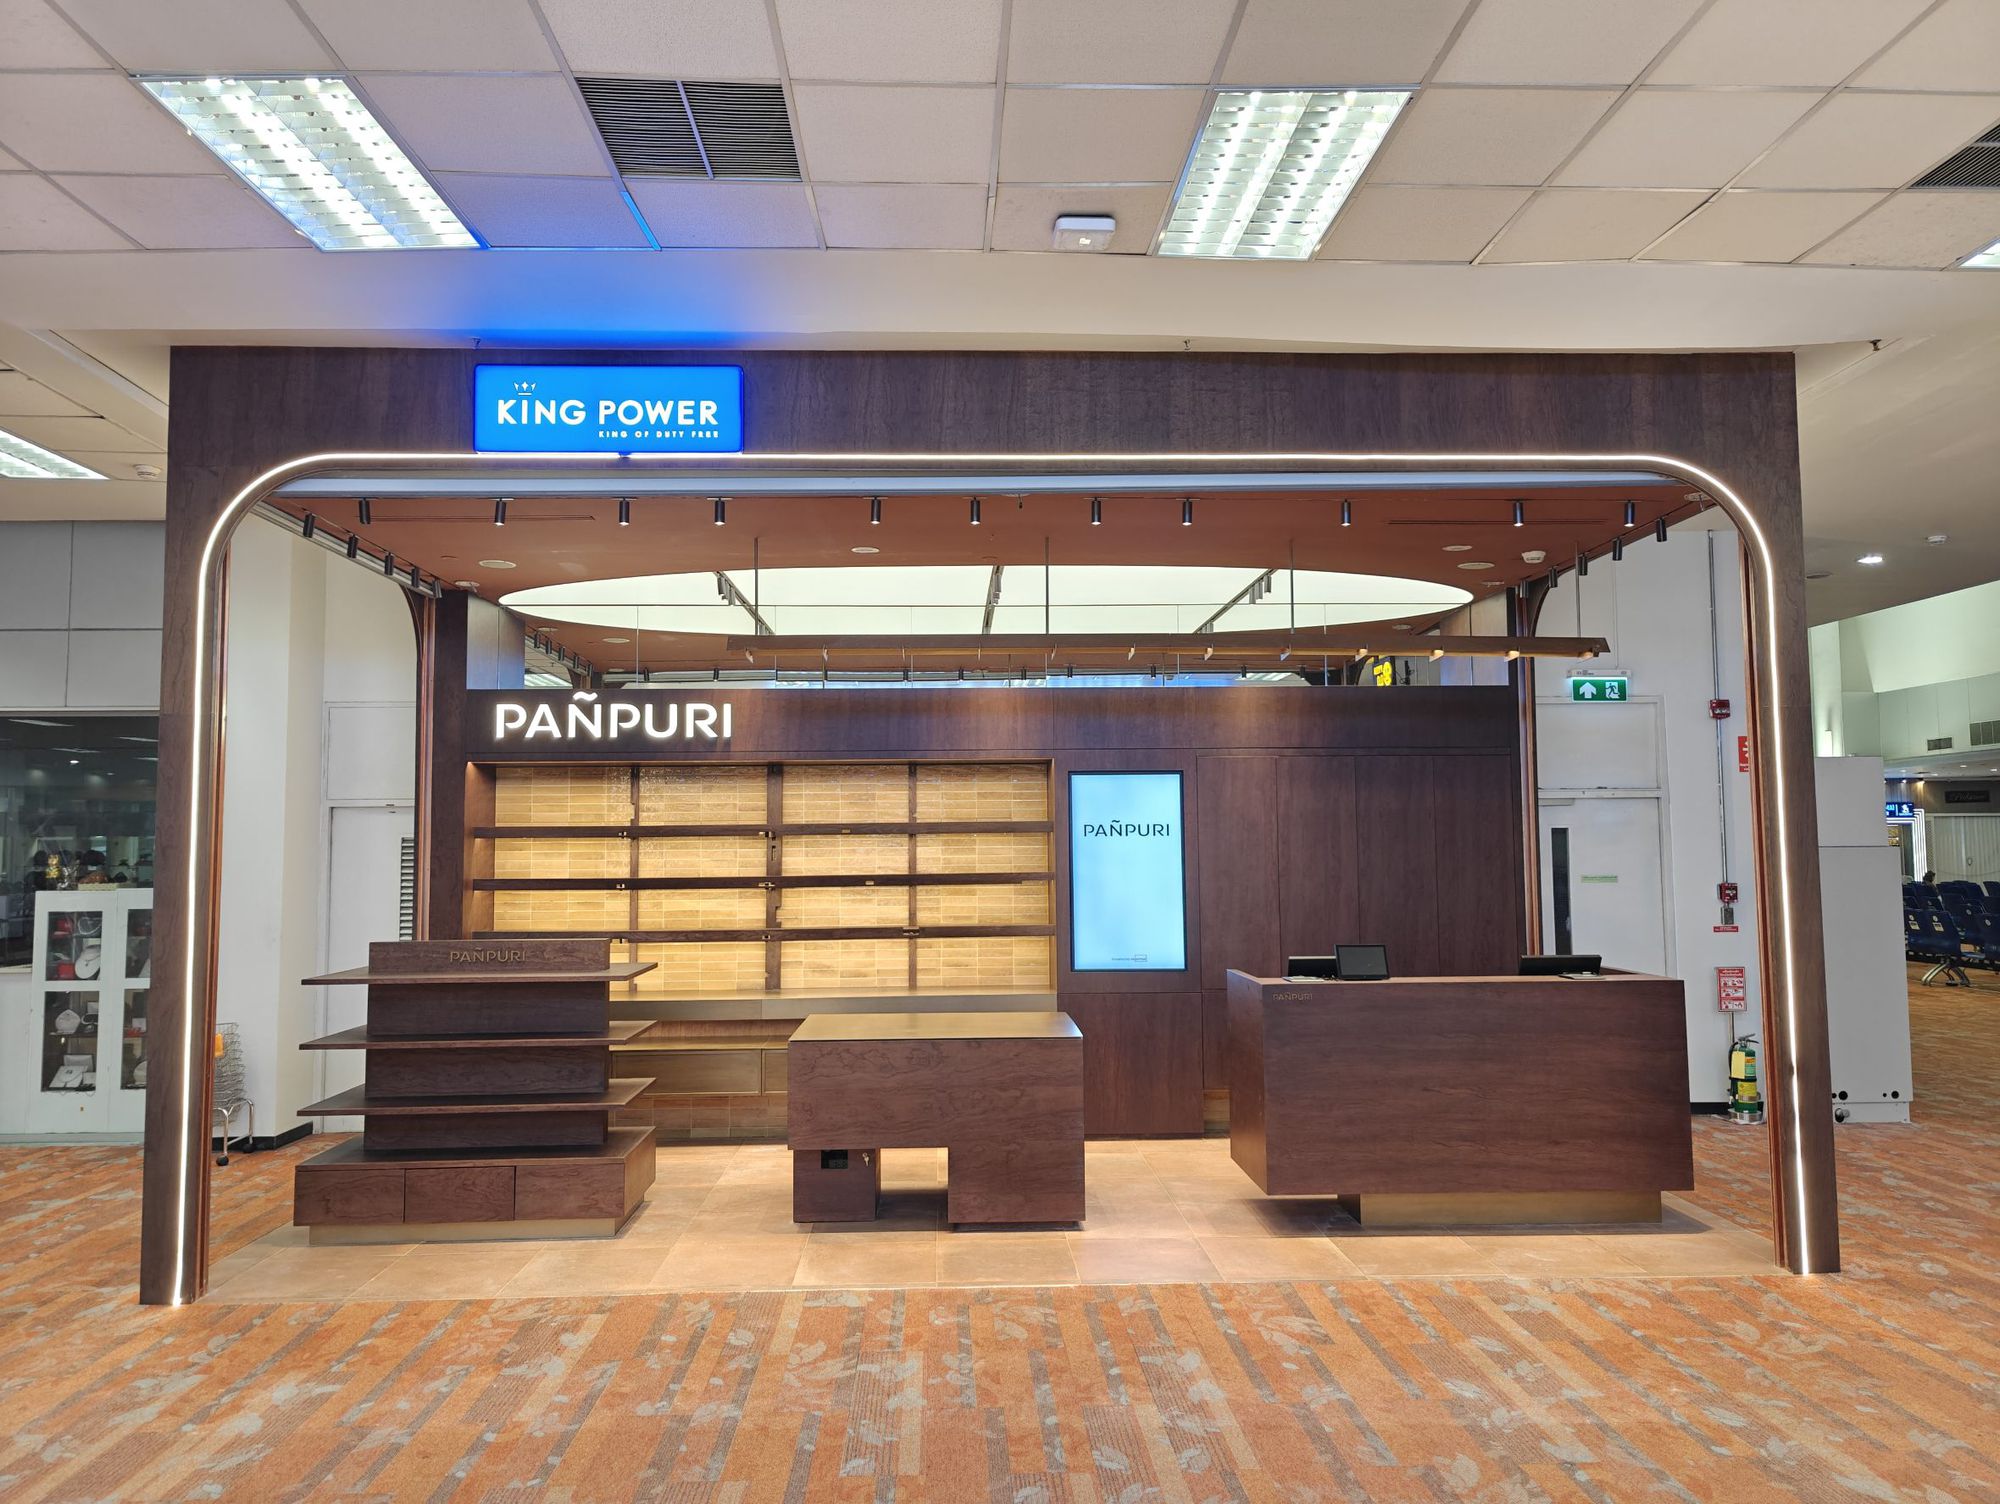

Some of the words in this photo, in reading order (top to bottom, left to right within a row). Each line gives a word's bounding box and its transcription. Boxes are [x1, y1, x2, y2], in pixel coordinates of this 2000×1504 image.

[498, 399, 587, 425] KING
[598, 399, 719, 426] POWER
[598, 430, 628, 438] KING
[635, 430, 649, 438] OF
[656, 430, 684, 438] DUTY
[691, 430, 719, 438] FREE
[496, 691, 732, 738] PAÑPURI
[1083, 819, 1170, 837] PAÑPURI
[449, 947, 527, 963] PAÑPURI
